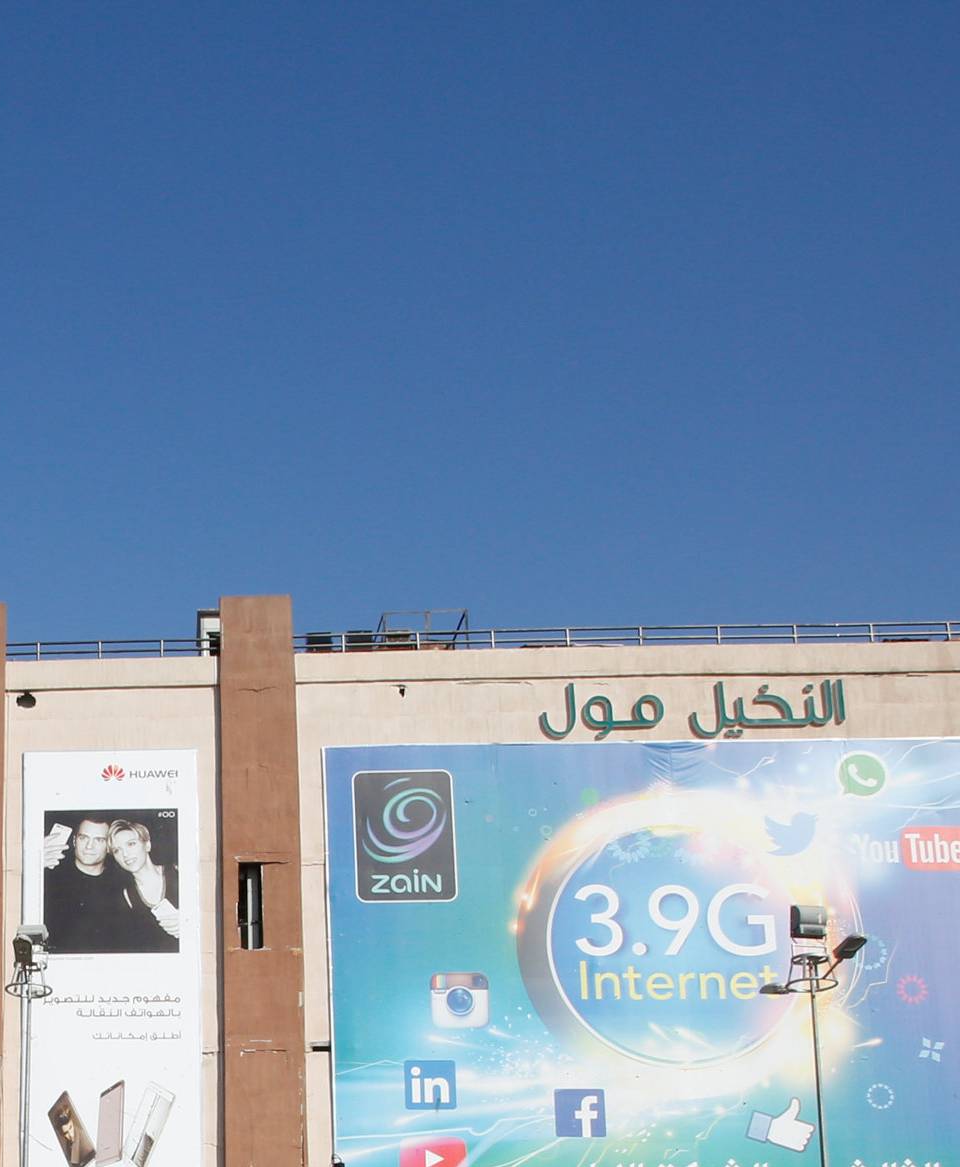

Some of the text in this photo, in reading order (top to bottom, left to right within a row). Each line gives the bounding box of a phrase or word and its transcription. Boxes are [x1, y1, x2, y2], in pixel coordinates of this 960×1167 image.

[538, 678, 846, 741] النخيل مول
[129, 769, 179, 779] HUAWEI
[573, 883, 778, 957] 3.9G
[132, 993, 182, 1005] مفهوم
[579, 959, 780, 1001] Internet
[411, 1066, 451, 1104] in
